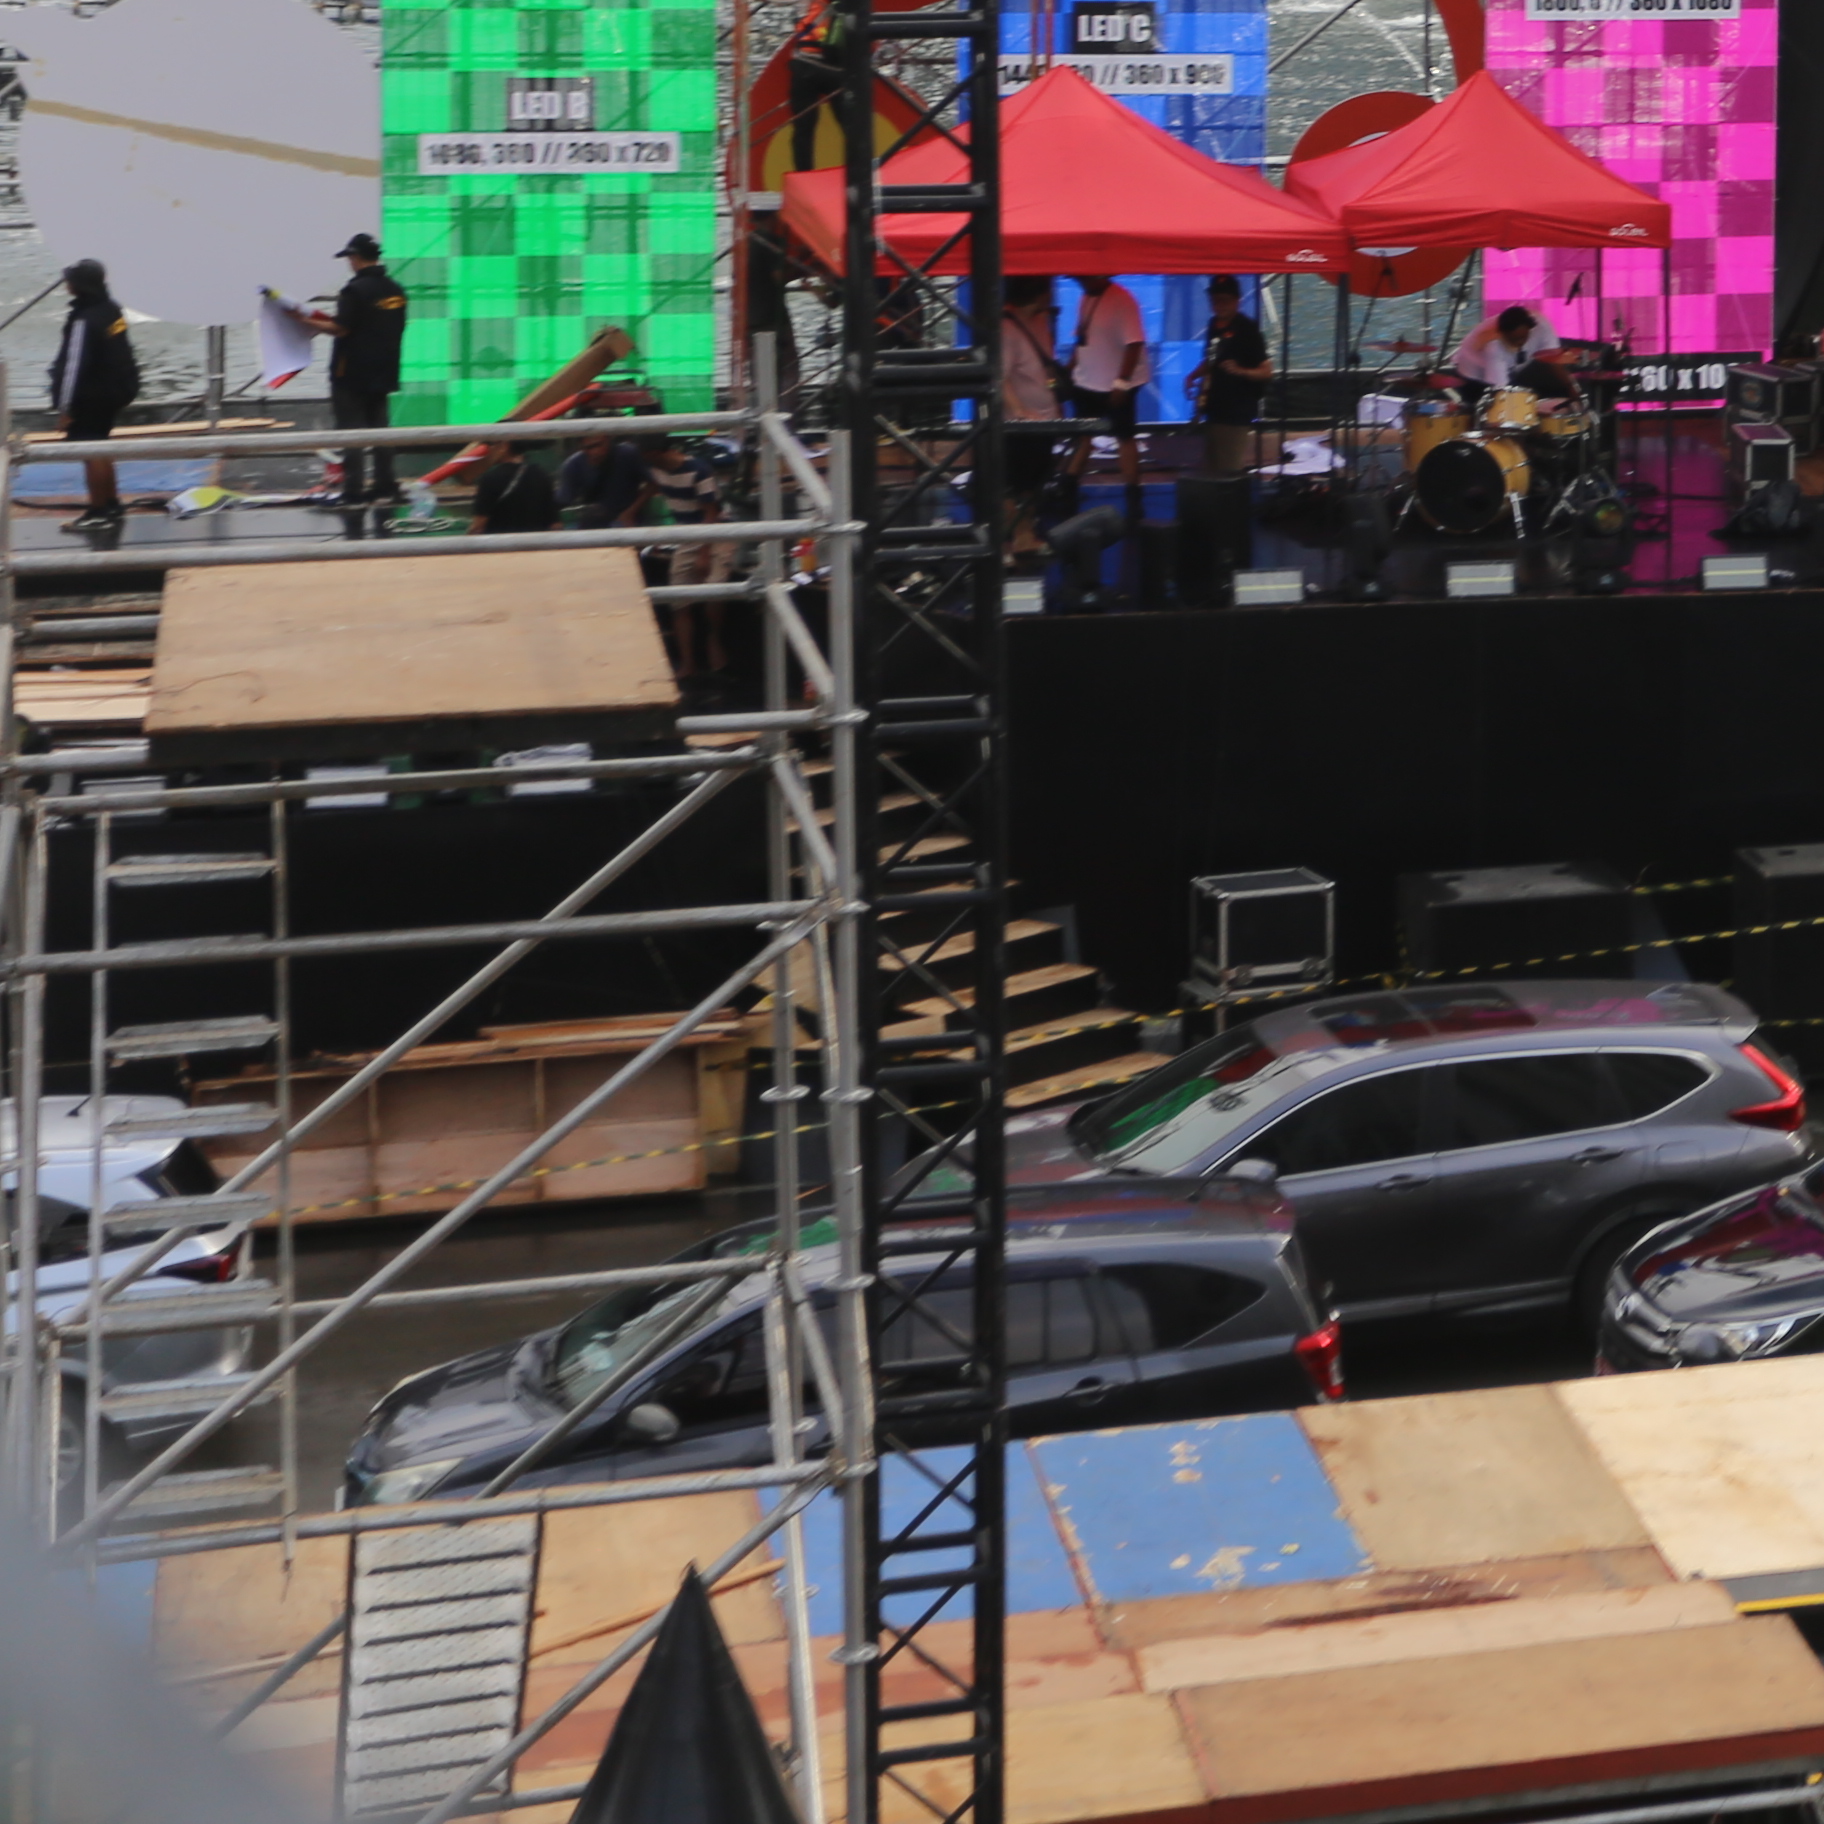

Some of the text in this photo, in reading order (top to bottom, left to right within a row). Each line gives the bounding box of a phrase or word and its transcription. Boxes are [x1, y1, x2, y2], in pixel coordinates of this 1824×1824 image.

[1077, 14, 1153, 43] LED C
[1125, 63, 1165, 85] 360
[1168, 67, 1181, 85] x
[511, 90, 590, 120] LED B
[1676, 368, 1694, 390] x
